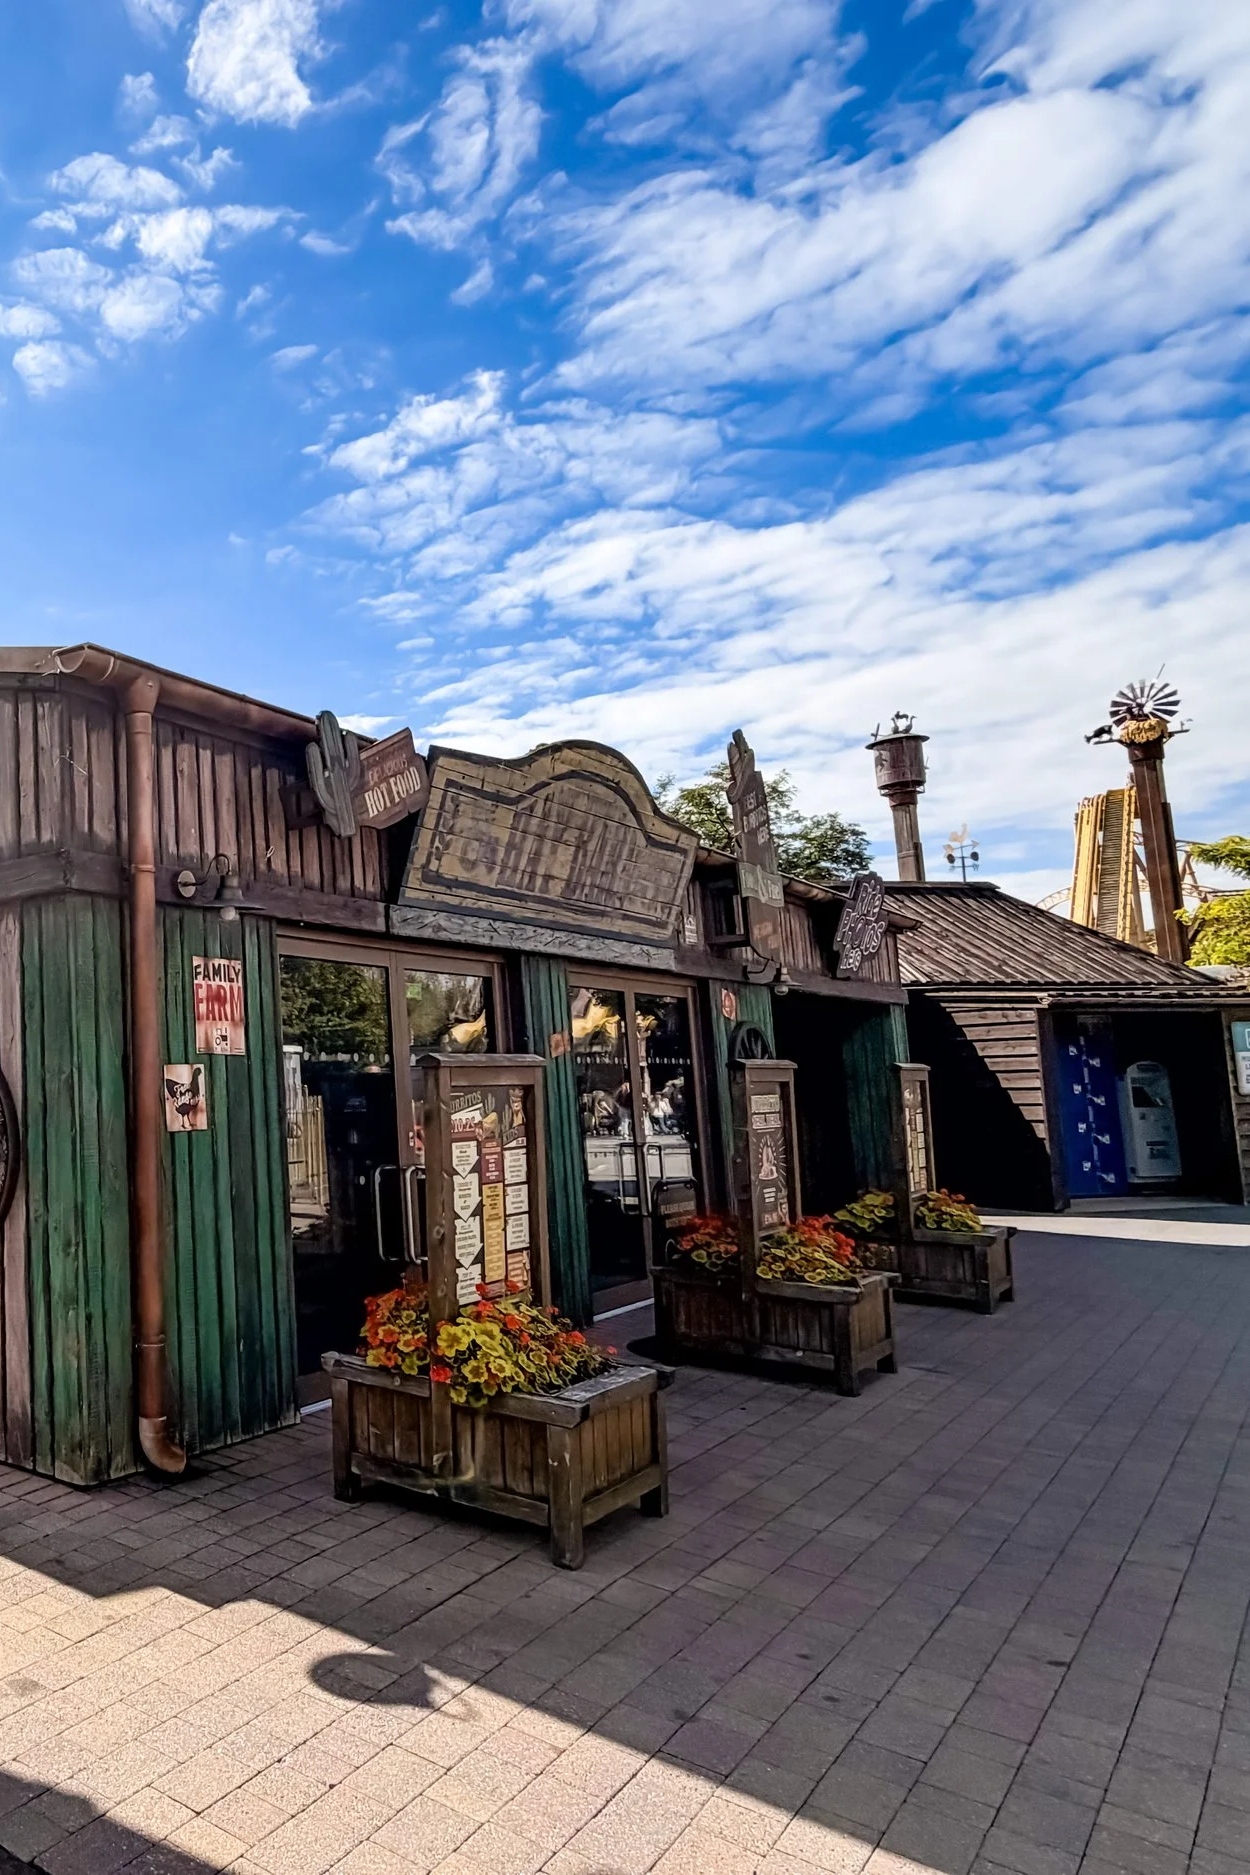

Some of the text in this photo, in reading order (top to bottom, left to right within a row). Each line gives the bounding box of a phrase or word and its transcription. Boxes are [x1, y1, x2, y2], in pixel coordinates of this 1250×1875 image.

[364, 766, 421, 818] HOT FOOD
[194, 962, 242, 984] FAMILY
[194, 983, 243, 1022] FARM
[450, 1090, 482, 1113] URRITOS
